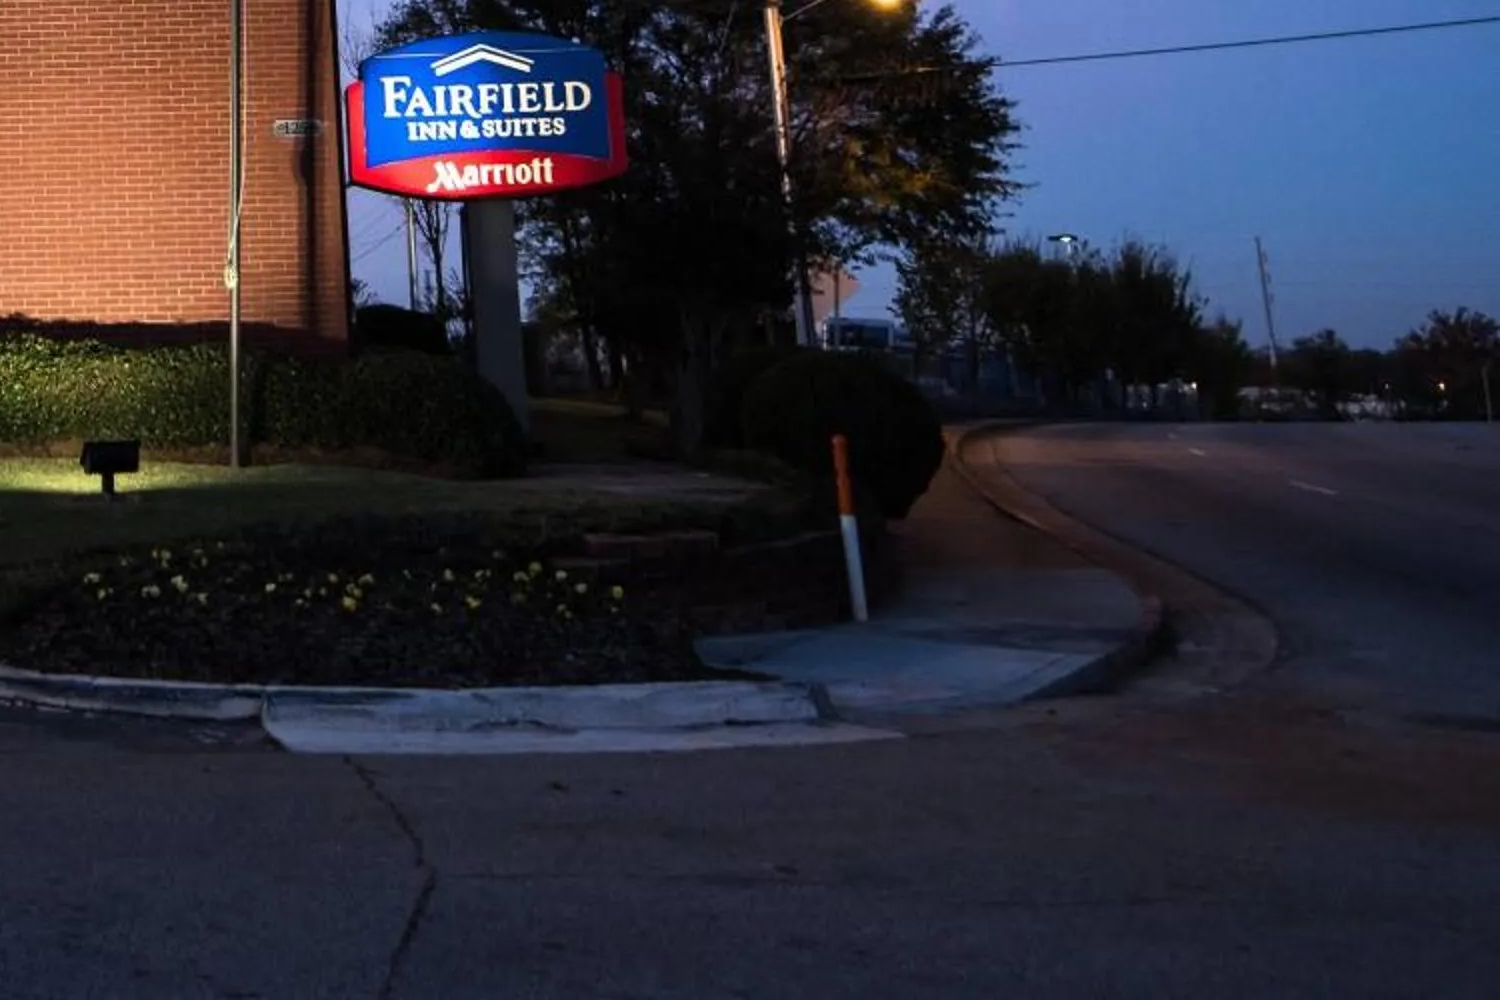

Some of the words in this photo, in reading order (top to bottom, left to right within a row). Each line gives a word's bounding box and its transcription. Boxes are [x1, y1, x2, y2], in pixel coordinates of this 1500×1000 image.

[380, 75, 592, 119] FAIRFIELD
[407, 121, 456, 141] INN
[460, 120, 481, 139] &
[482, 117, 566, 137] SUITES
[426, 157, 554, 193] Marriott
